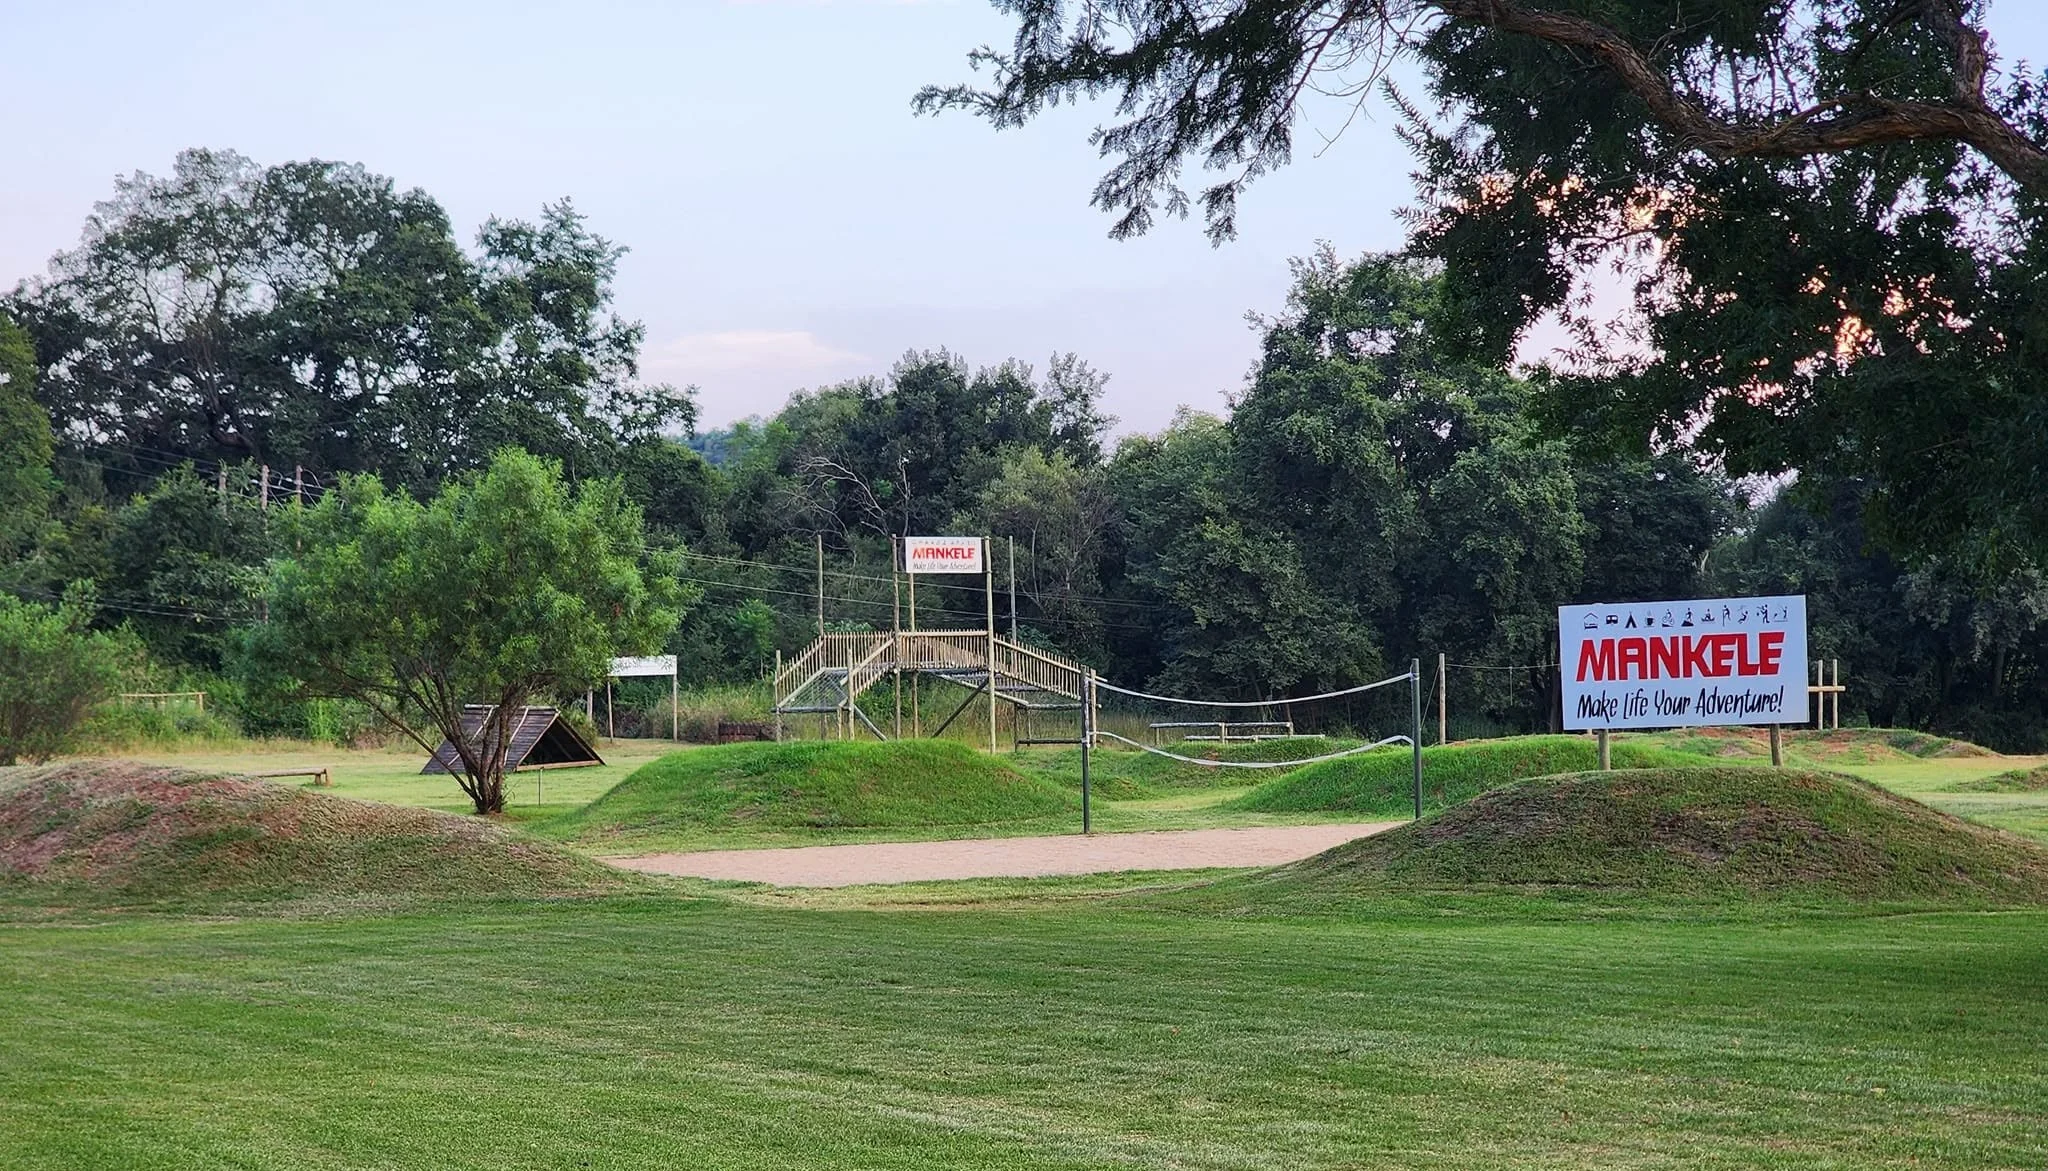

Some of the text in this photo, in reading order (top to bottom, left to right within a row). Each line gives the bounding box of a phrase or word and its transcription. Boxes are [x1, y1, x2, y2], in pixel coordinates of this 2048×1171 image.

[912, 547, 976, 560] MANKELE
[1576, 631, 1785, 682] MANKELE
[1577, 685, 1785, 723] Make Life Your Adventure!
